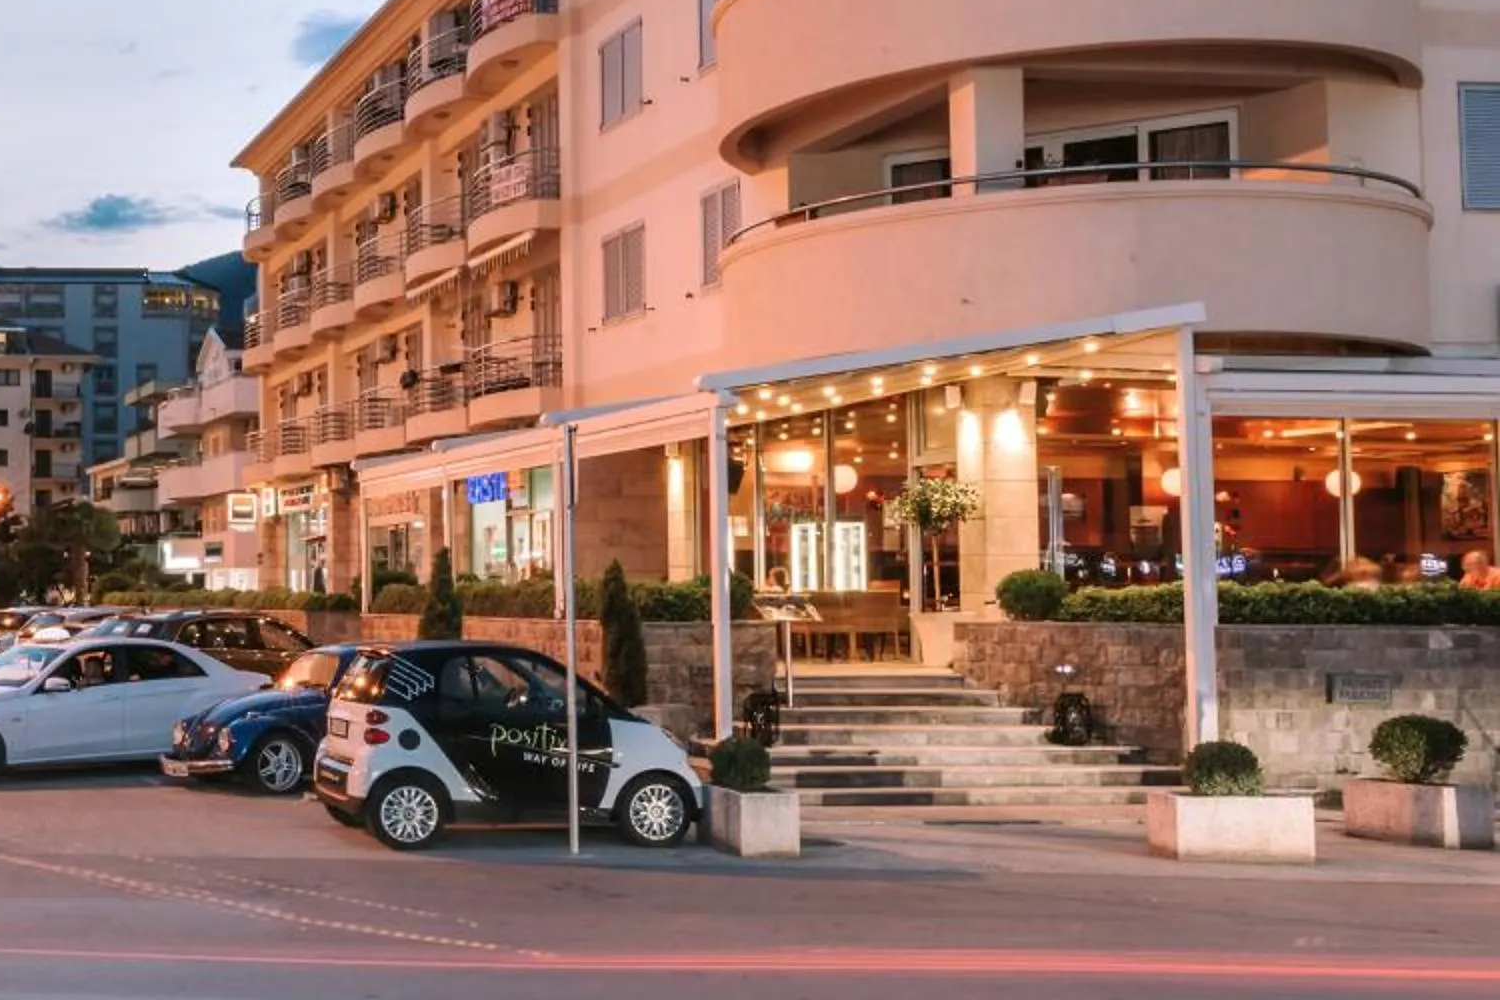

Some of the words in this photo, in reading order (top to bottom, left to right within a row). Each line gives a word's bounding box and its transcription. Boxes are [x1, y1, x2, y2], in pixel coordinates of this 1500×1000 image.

[489, 721, 568, 757] positiv
[523, 751, 547, 766] WAY
[577, 762, 596, 773] IFE
